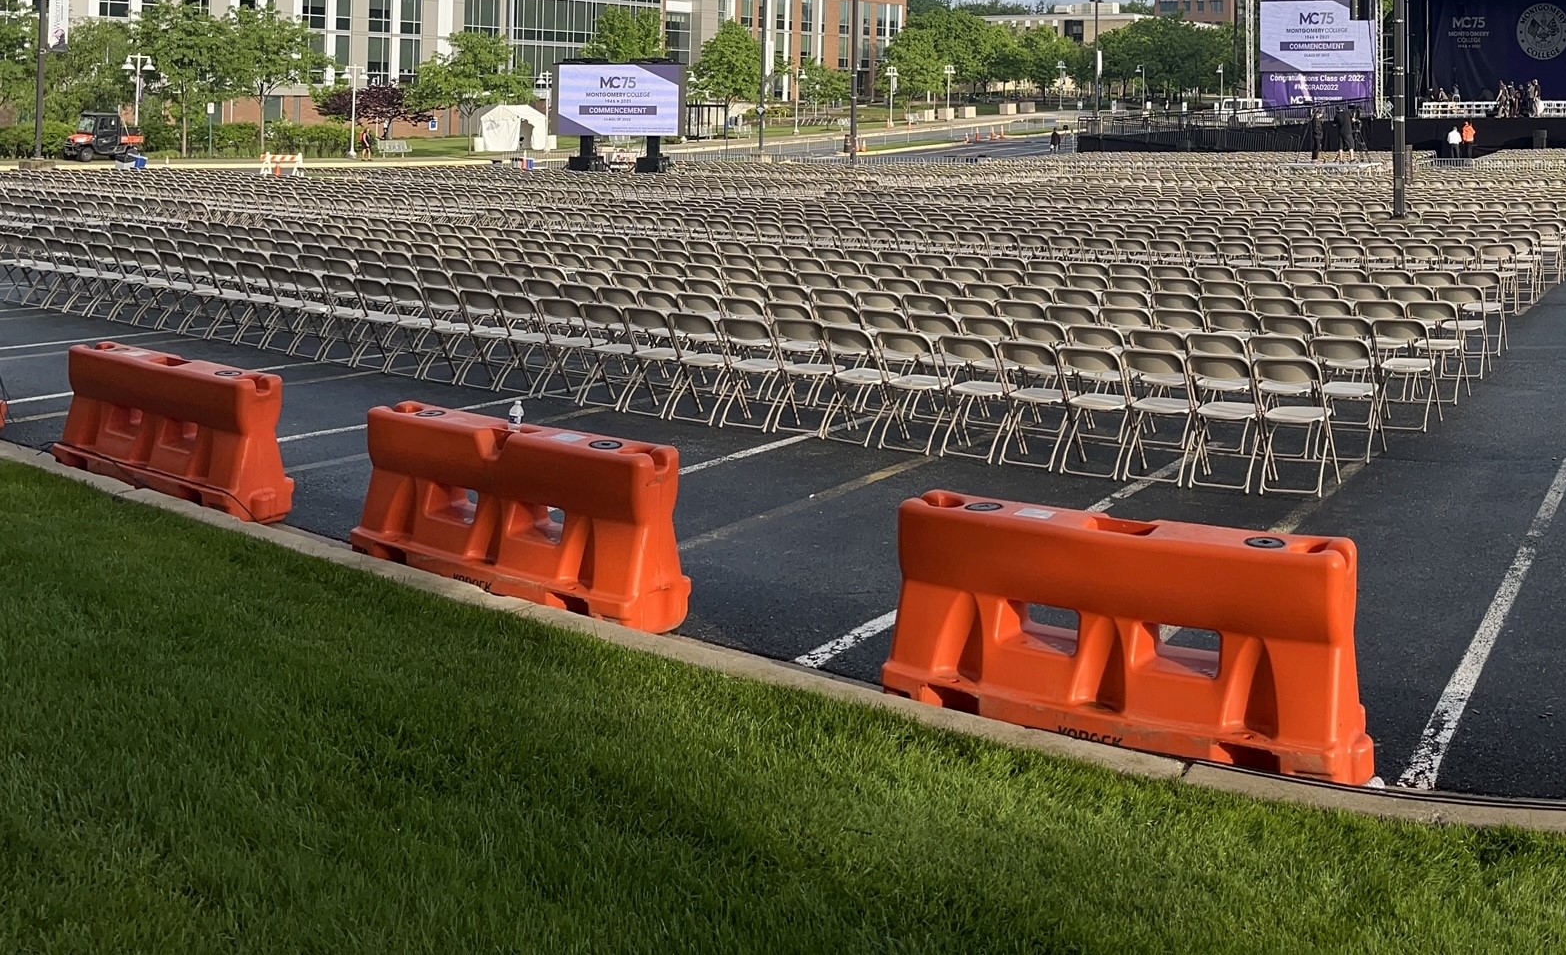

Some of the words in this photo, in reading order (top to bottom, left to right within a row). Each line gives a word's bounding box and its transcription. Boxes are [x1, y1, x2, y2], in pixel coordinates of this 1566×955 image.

[1300, 12, 1334, 25] MC75
[1452, 16, 1486, 29] MC75
[1526, 47, 1560, 59] COLLEGE
[600, 76, 636, 89] MC75
